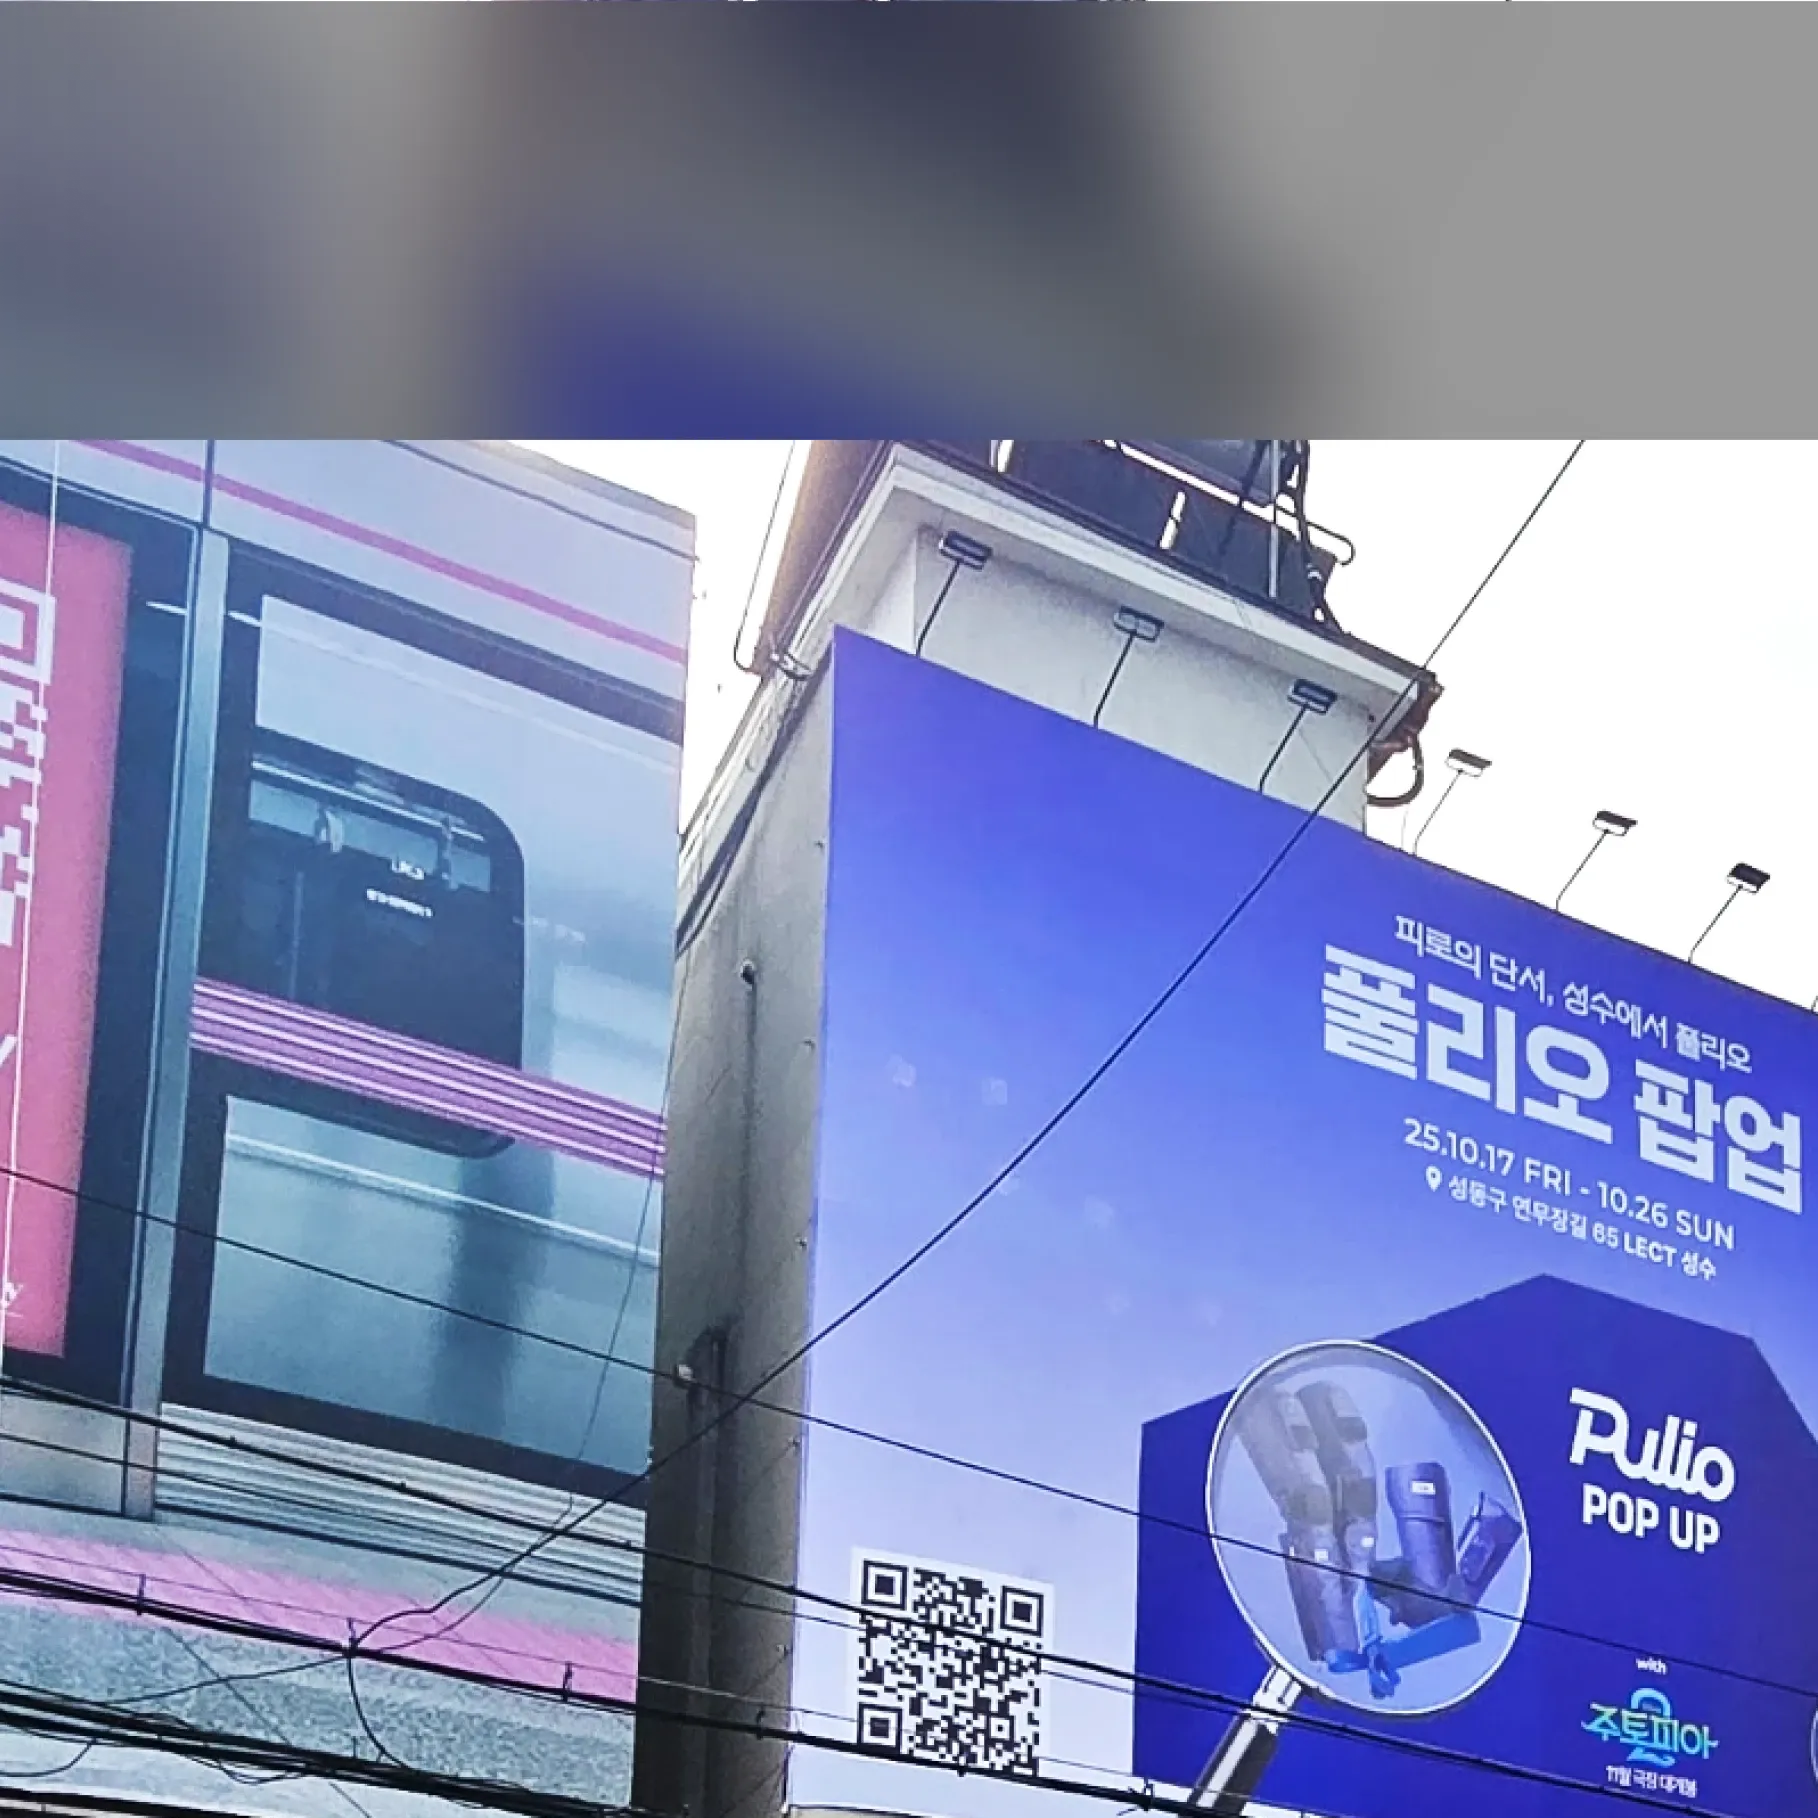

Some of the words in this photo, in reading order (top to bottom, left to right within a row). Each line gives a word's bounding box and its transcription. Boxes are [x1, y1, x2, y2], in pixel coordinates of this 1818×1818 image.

[1395, 915, 1482, 980] 피로의
[1489, 952, 1555, 1007] 단서,
[1563, 981, 1668, 1049] 성수에서
[1321, 943, 1614, 1145] 풀리오
[1634, 1058, 1802, 1216] 팝업
[1403, 1117, 1516, 1177] 25.10.17
[1523, 1157, 1571, 1197] FRI
[1596, 1180, 1669, 1229] 10.26
[1676, 1209, 1736, 1251] SUN
[1448, 1174, 1508, 1214] 성동구
[1623, 1231, 1679, 1268] LECT
[1569, 1387, 1736, 1503] Pulio
[1581, 1482, 1660, 1538] POP
[1668, 1508, 1721, 1554] UP
